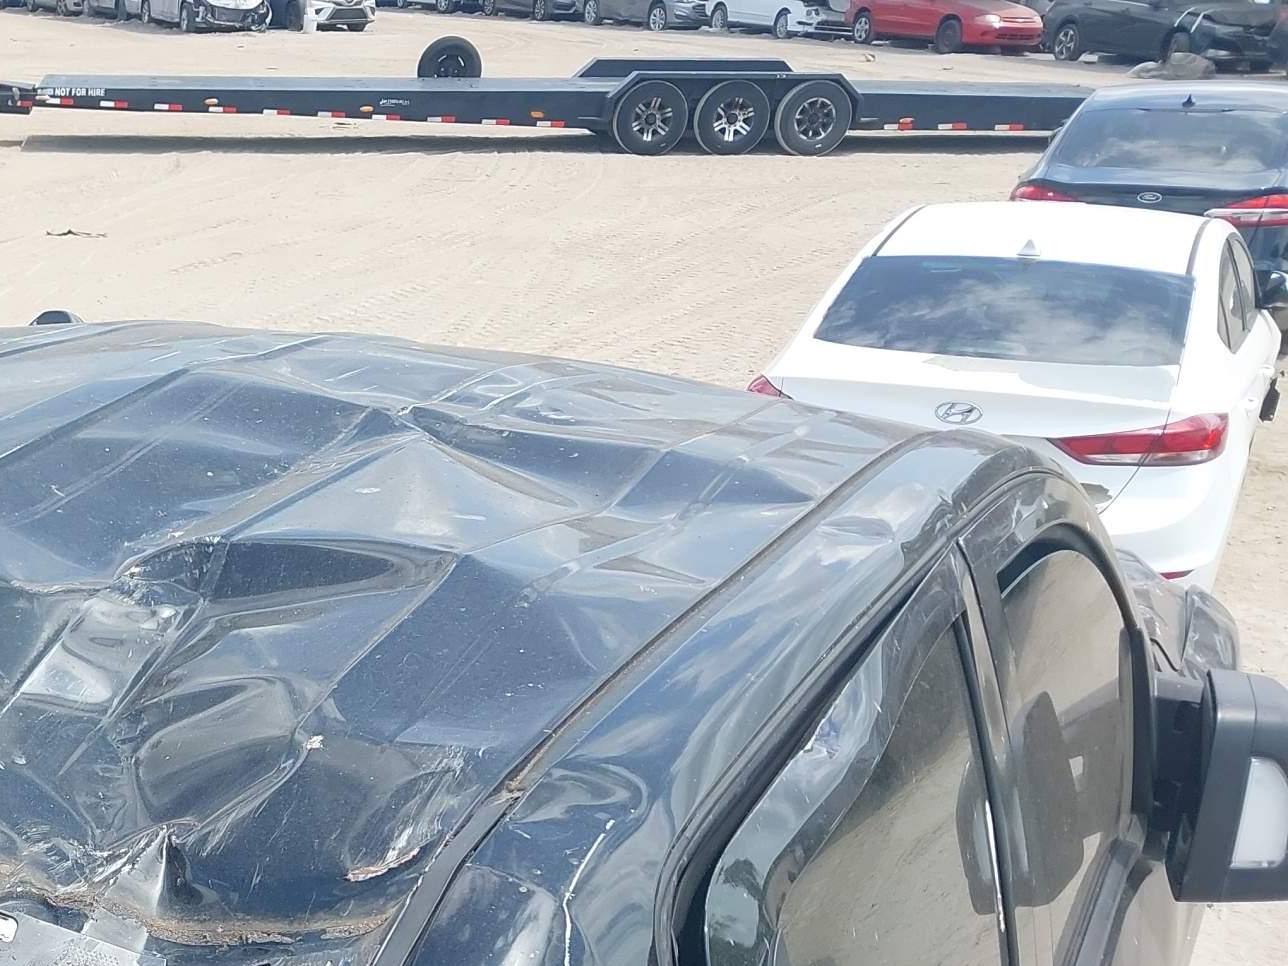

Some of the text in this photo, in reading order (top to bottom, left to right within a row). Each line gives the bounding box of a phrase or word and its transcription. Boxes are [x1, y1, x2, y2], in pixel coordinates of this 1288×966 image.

[55, 87, 71, 97] NOT
[72, 87, 87, 97] FOR
[88, 88, 106, 97] HIRE
